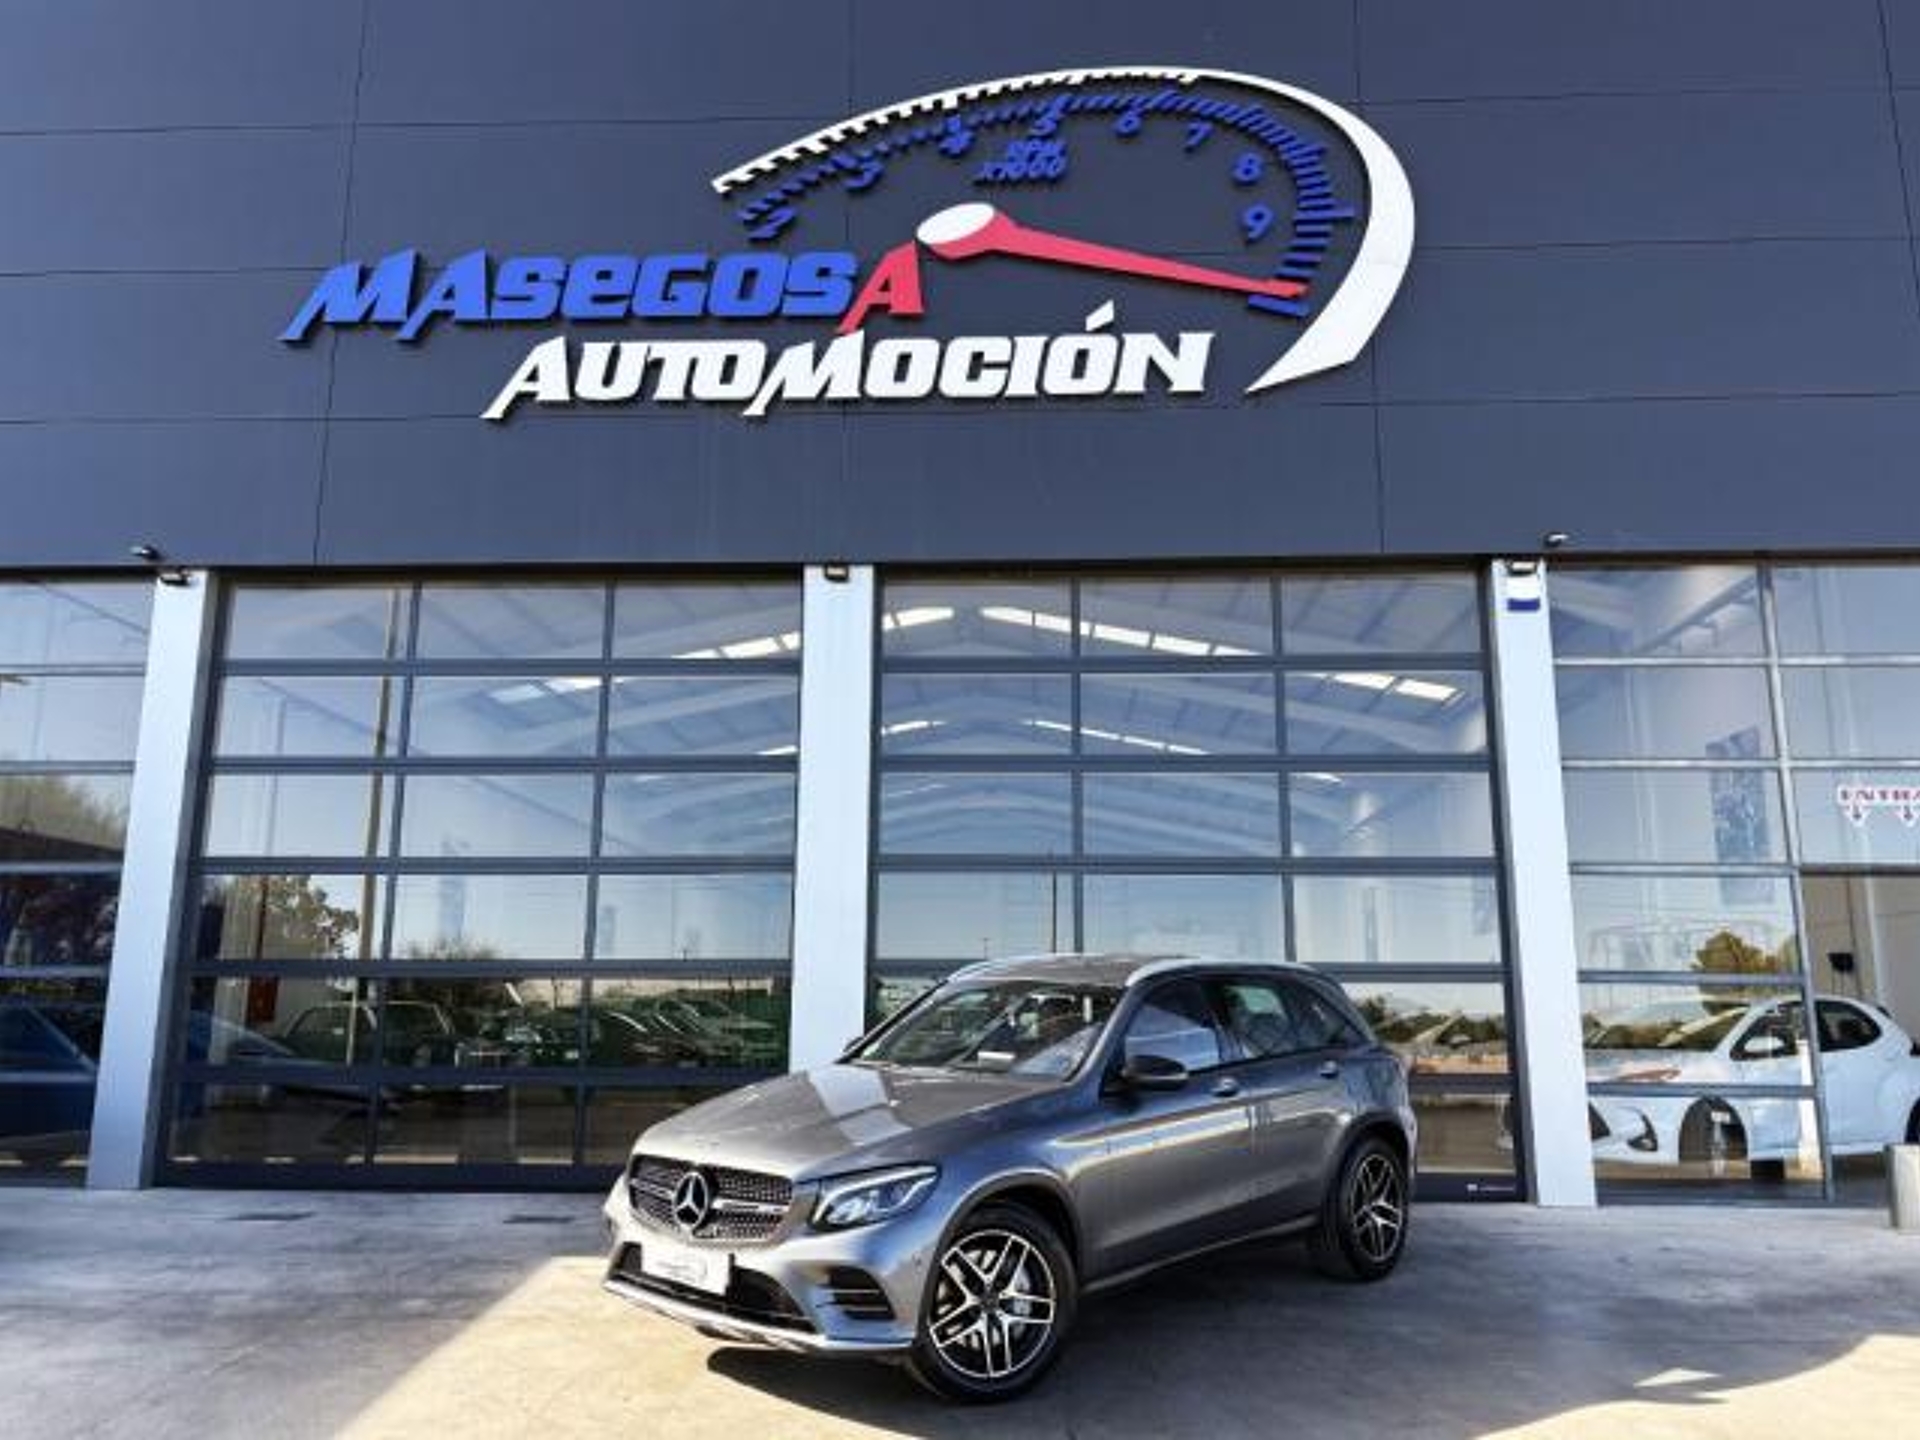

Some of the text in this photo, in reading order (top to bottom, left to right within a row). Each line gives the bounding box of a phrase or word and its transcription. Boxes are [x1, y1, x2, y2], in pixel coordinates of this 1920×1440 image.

[1115, 106, 1146, 135] 6
[1186, 122, 1214, 147] 7
[1232, 152, 1264, 184] 8
[1243, 204, 1274, 239] 9
[479, 302, 1214, 419] AUTOMOCIÓN
